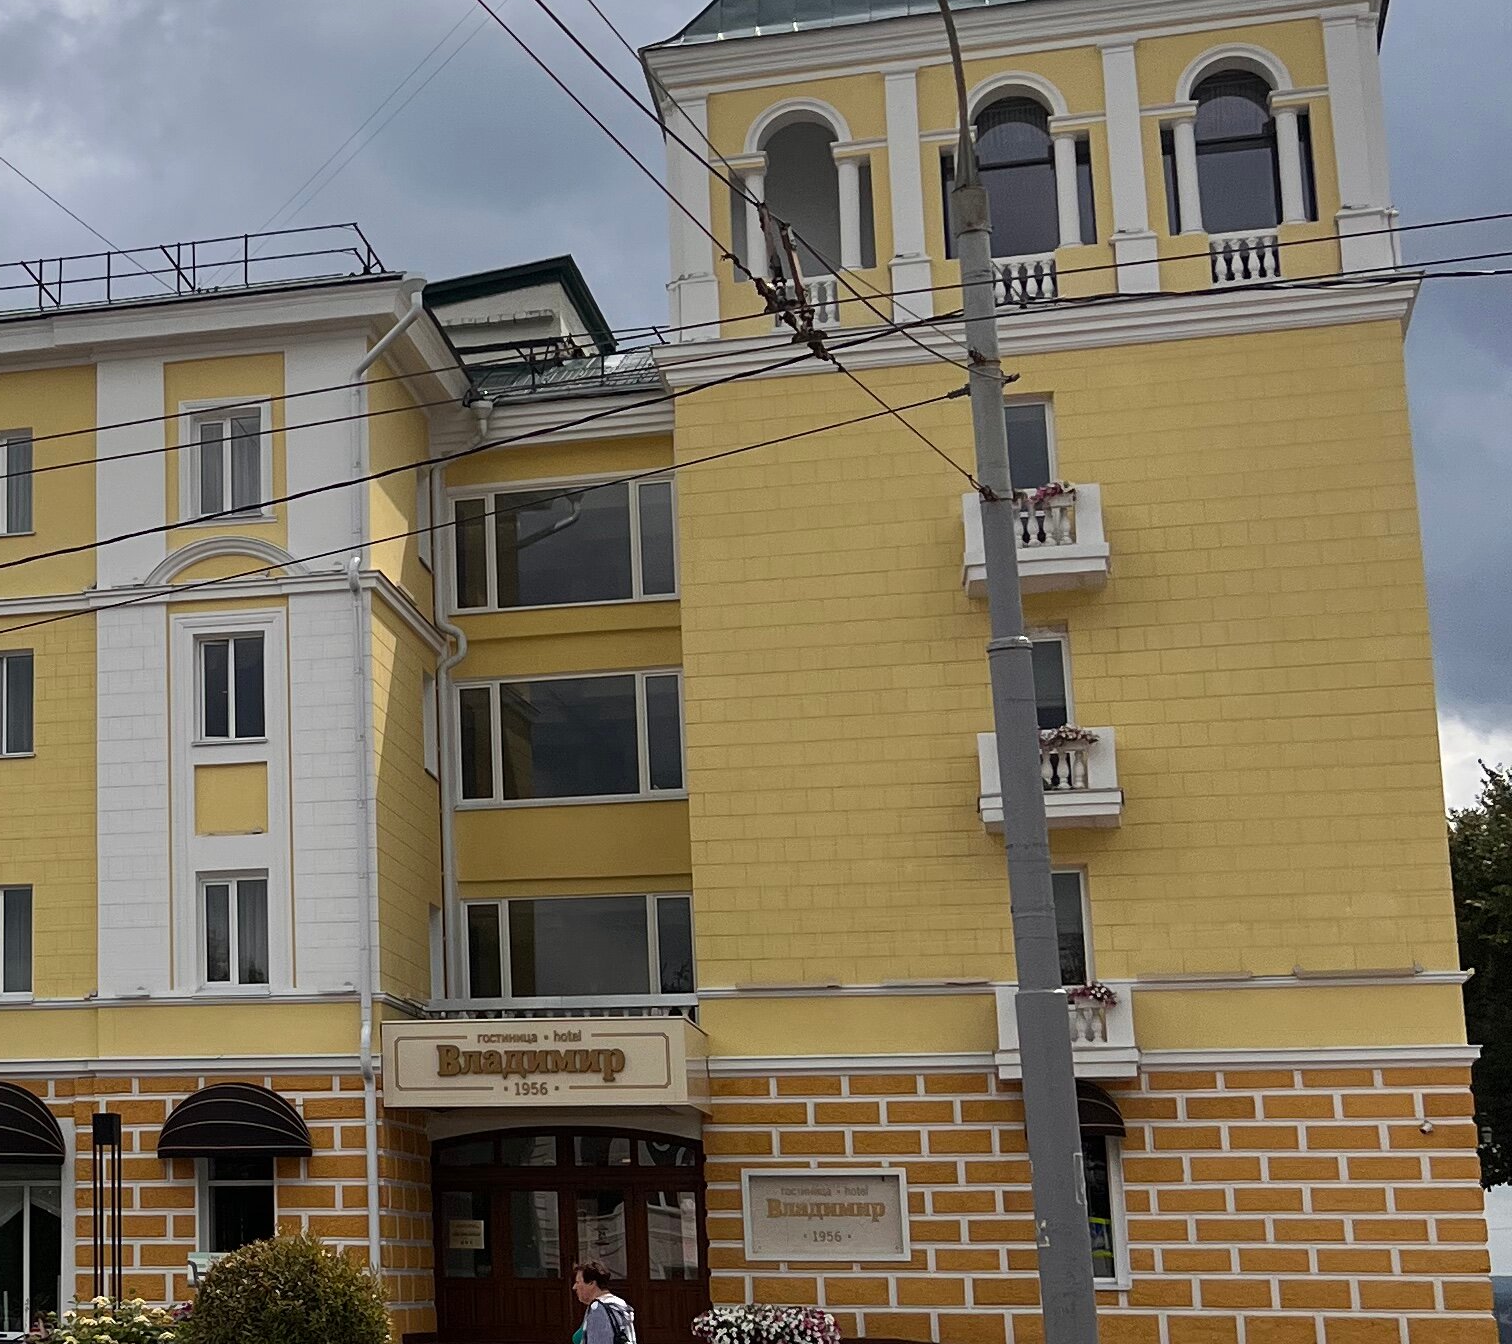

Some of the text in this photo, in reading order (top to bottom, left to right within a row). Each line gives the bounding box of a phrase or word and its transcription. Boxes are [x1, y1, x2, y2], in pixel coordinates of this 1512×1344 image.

[477, 1030, 582, 1043] гостиница hotel
[436, 1044, 626, 1082] Владимир
[514, 1082, 548, 1096] 1956
[766, 1199, 885, 1222] Владимир
[813, 1230, 842, 1243] 1956
